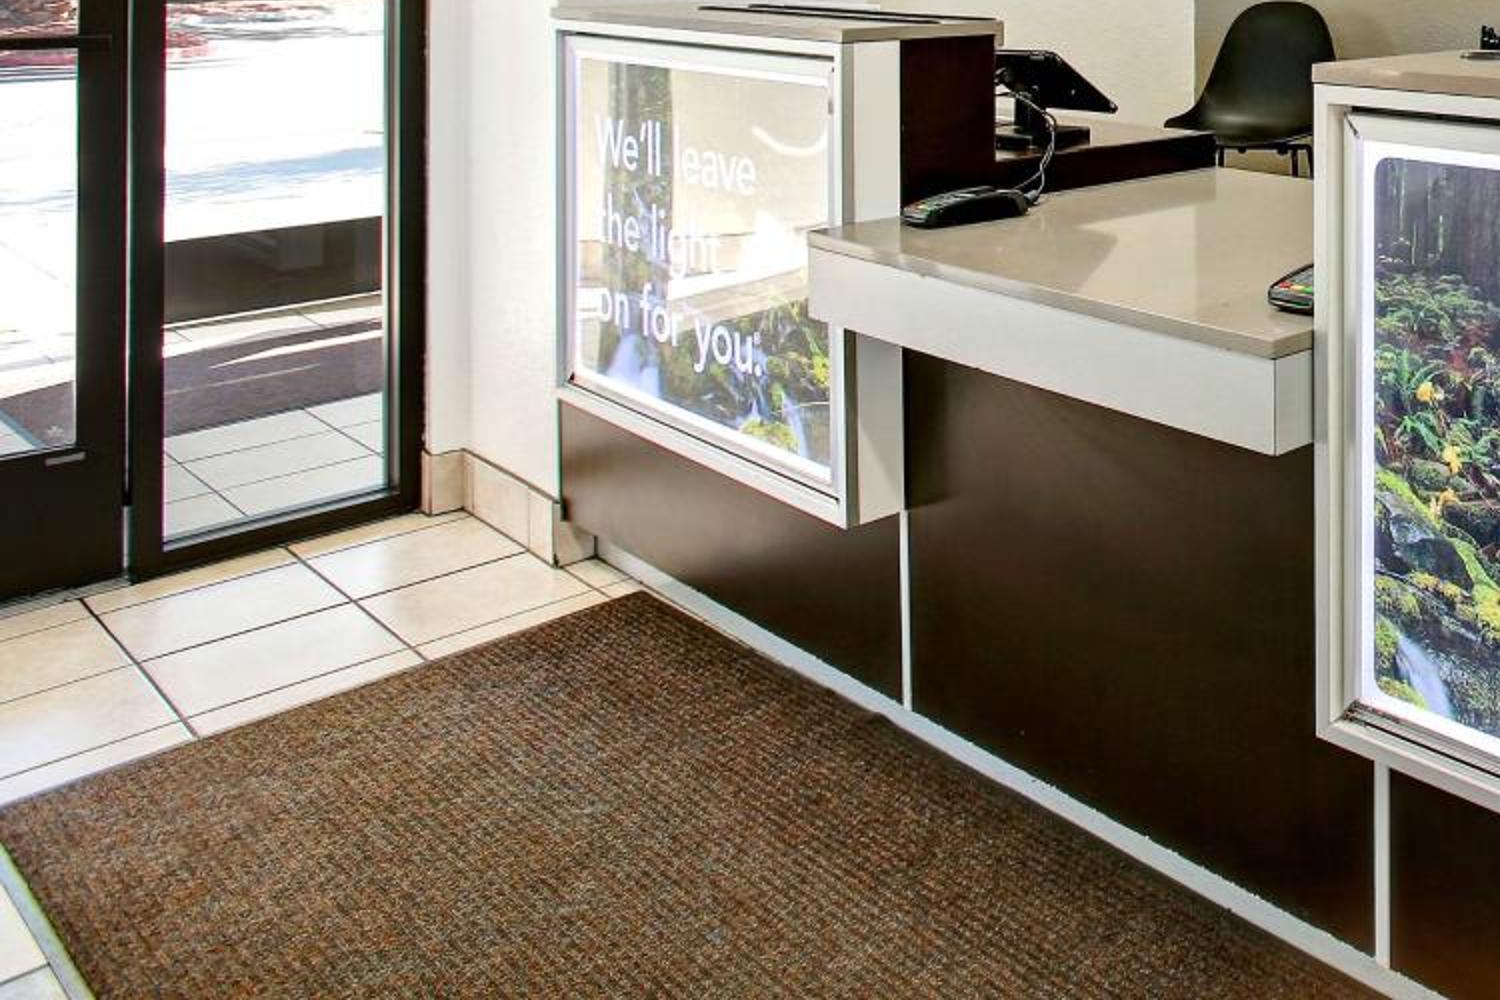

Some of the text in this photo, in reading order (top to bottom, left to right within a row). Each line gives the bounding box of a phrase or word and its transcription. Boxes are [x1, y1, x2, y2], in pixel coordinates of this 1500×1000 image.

[594, 113, 757, 197] We'll leave
[599, 286, 630, 329] on
[640, 281, 682, 348] for
